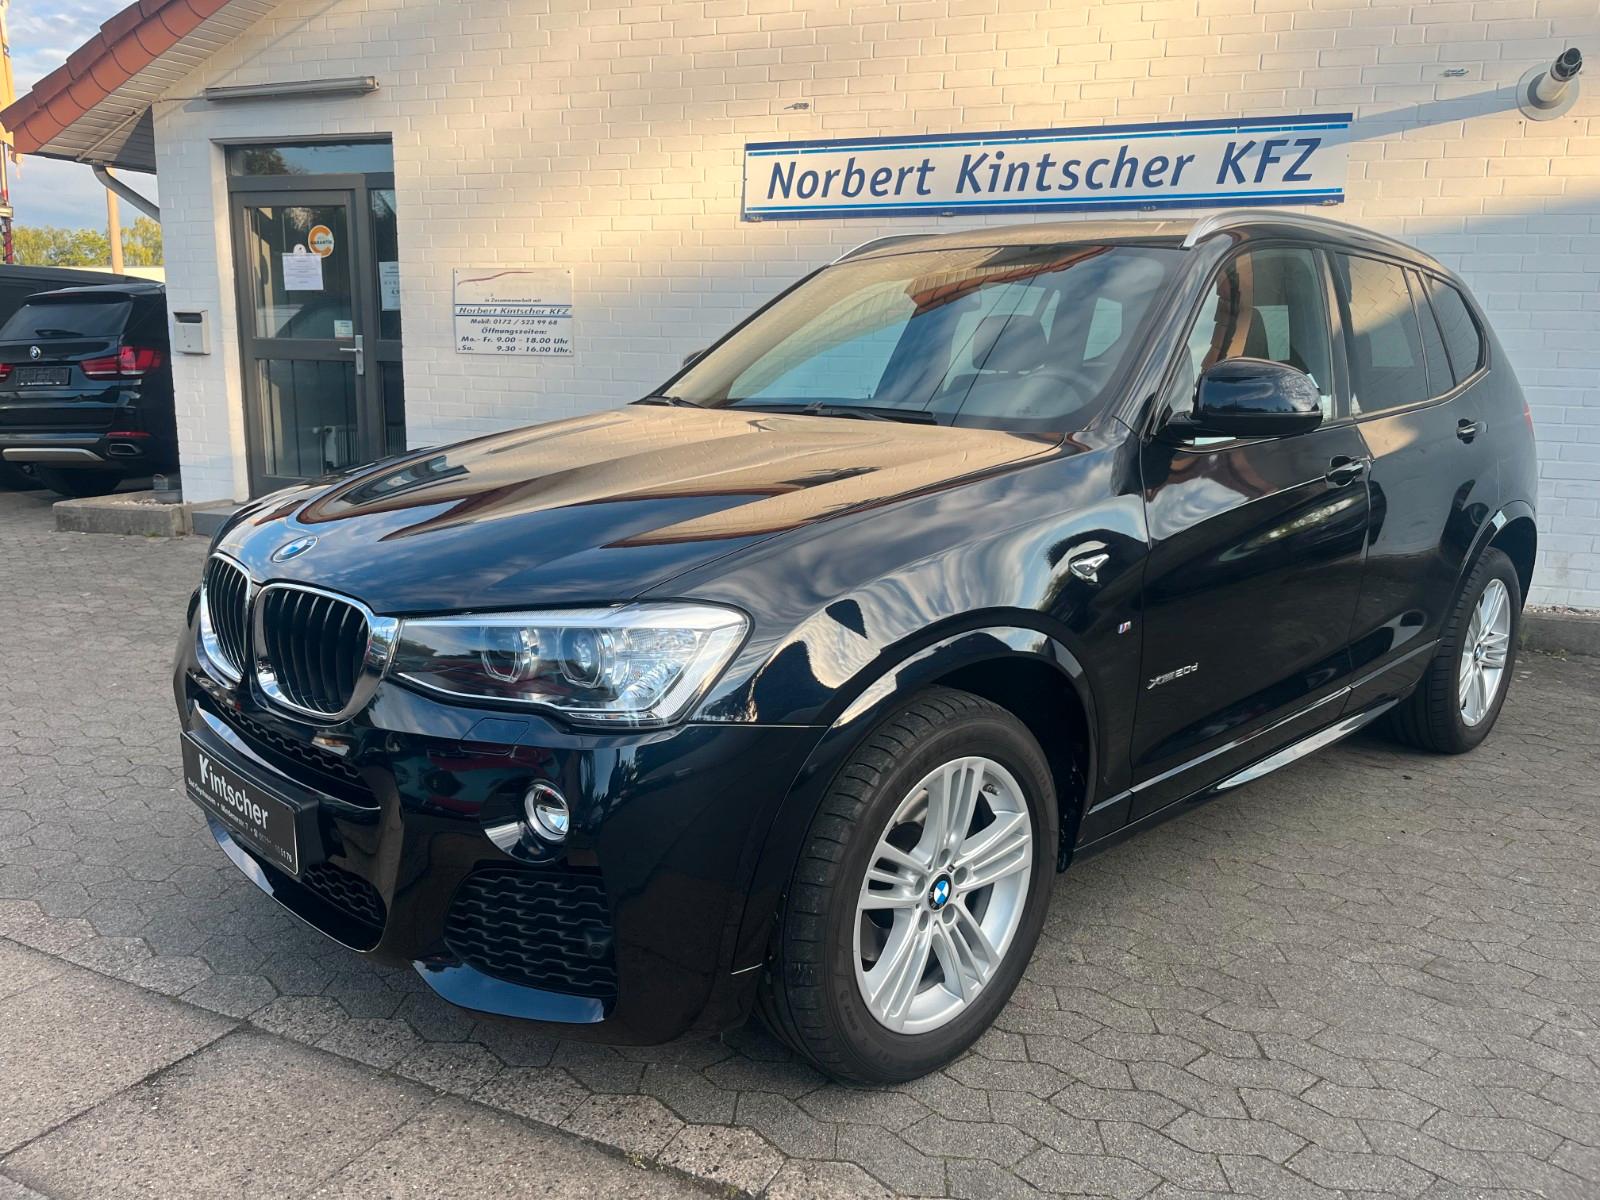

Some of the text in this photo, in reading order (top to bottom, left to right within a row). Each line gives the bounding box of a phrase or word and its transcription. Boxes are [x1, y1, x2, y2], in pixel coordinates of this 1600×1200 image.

[767, 138, 1322, 200] Norbert Kintscher KFZ
[459, 307, 497, 315] Norbert
[500, 307, 546, 315] Kintscher
[481, 327, 548, 336] Öffnungszeiten:
[553, 337, 569, 345] Uhr
[199, 754, 268, 829] Kintscher
